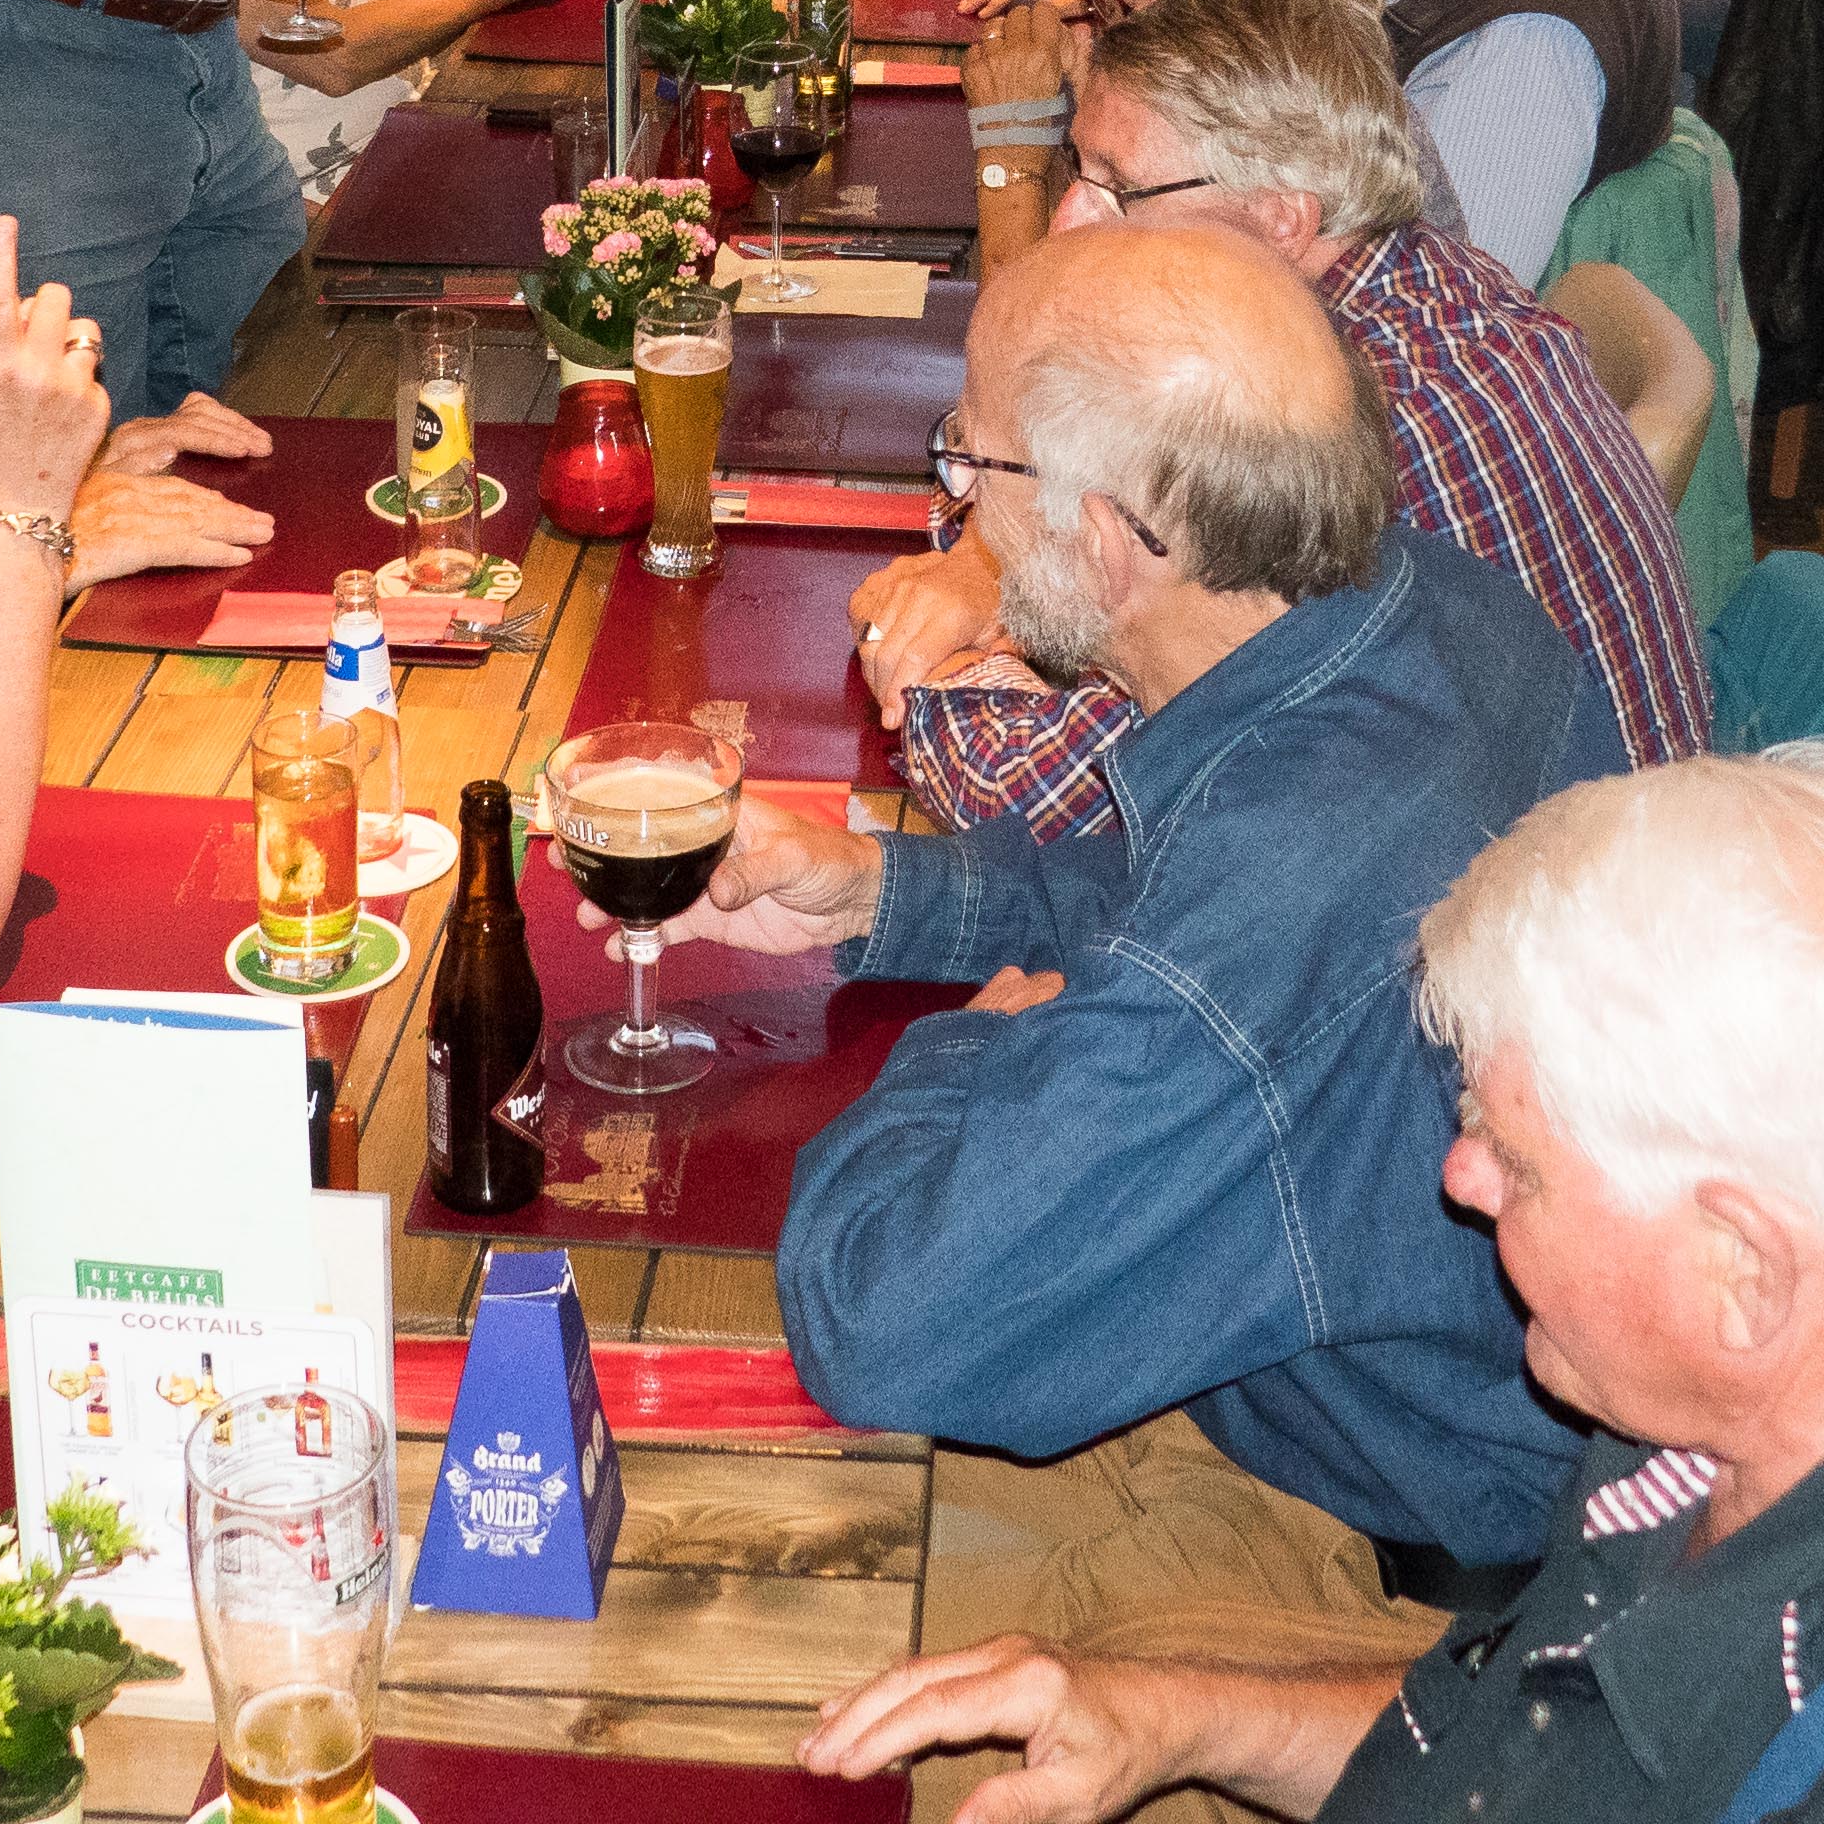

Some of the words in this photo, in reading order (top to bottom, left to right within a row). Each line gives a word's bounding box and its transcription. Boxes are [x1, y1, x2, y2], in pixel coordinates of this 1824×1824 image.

[90, 1267, 208, 1290] EETCAFÉ
[121, 1312, 264, 1337] COCKTAILS
[473, 1444, 542, 1473] Brand
[469, 1488, 539, 1528] PORTER
